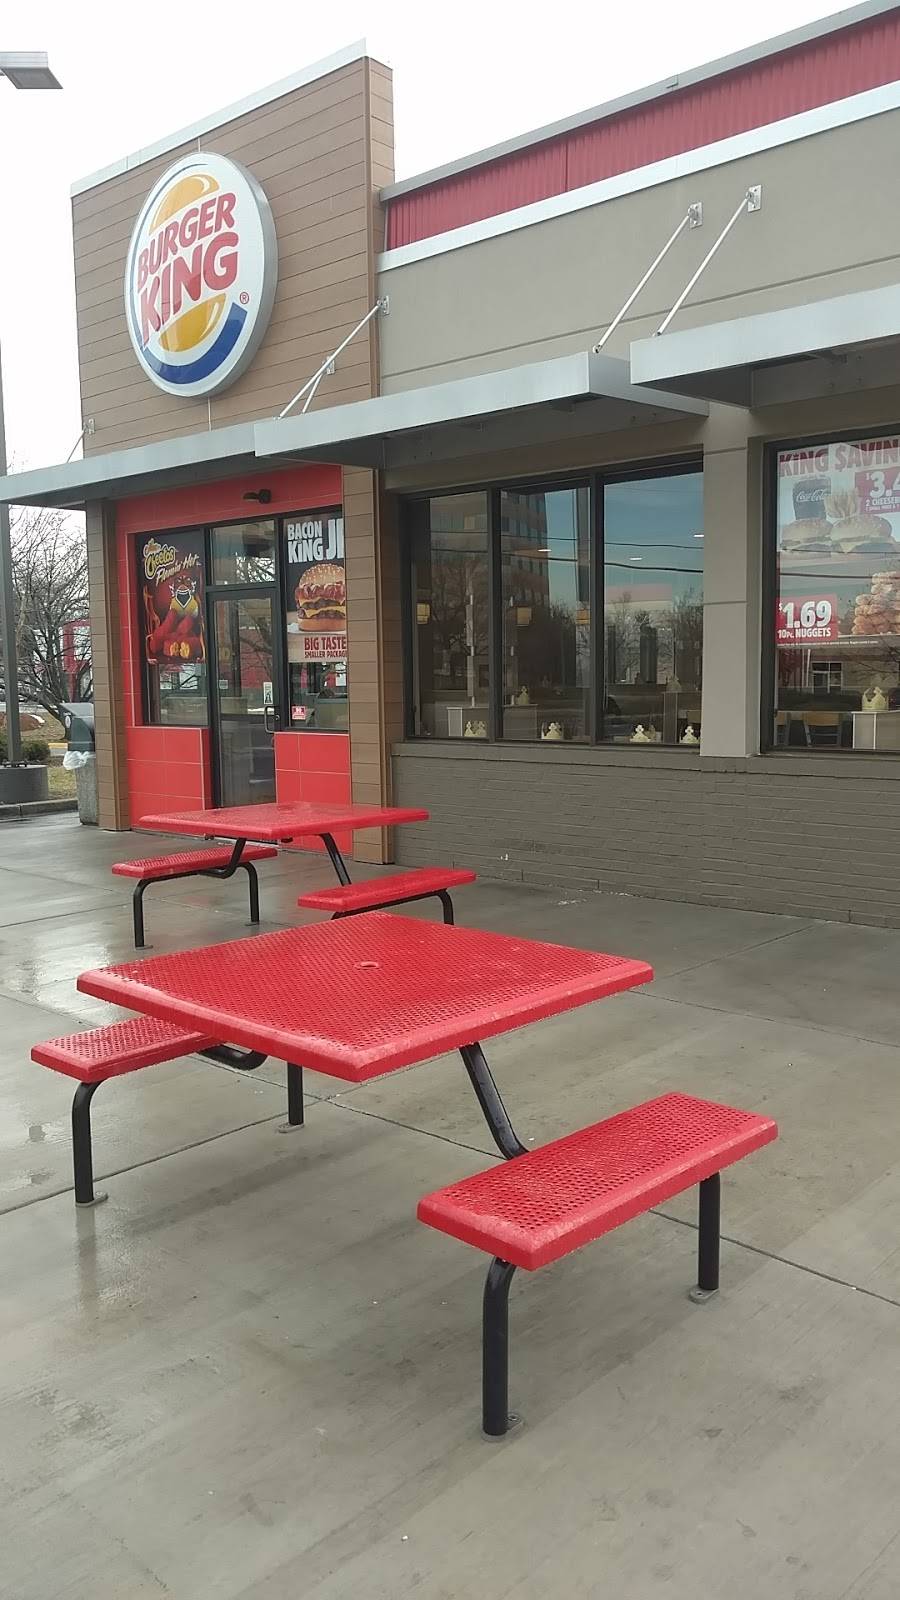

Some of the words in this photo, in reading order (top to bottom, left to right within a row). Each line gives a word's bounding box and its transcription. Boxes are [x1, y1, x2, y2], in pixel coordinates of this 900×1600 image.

[137, 192, 236, 293] BURGER
[142, 232, 239, 346] KING
[779, 448, 829, 477] KING
[287, 520, 323, 541] BACON
[182, 552, 200, 570] Hot
[287, 537, 324, 564] KING
[145, 547, 175, 579] Cheetos
[304, 637, 320, 651] BIG
[320, 636, 347, 650] TASTE
[795, 628, 832, 639] NUGGETS
[304, 650, 326, 659] SMALLER
